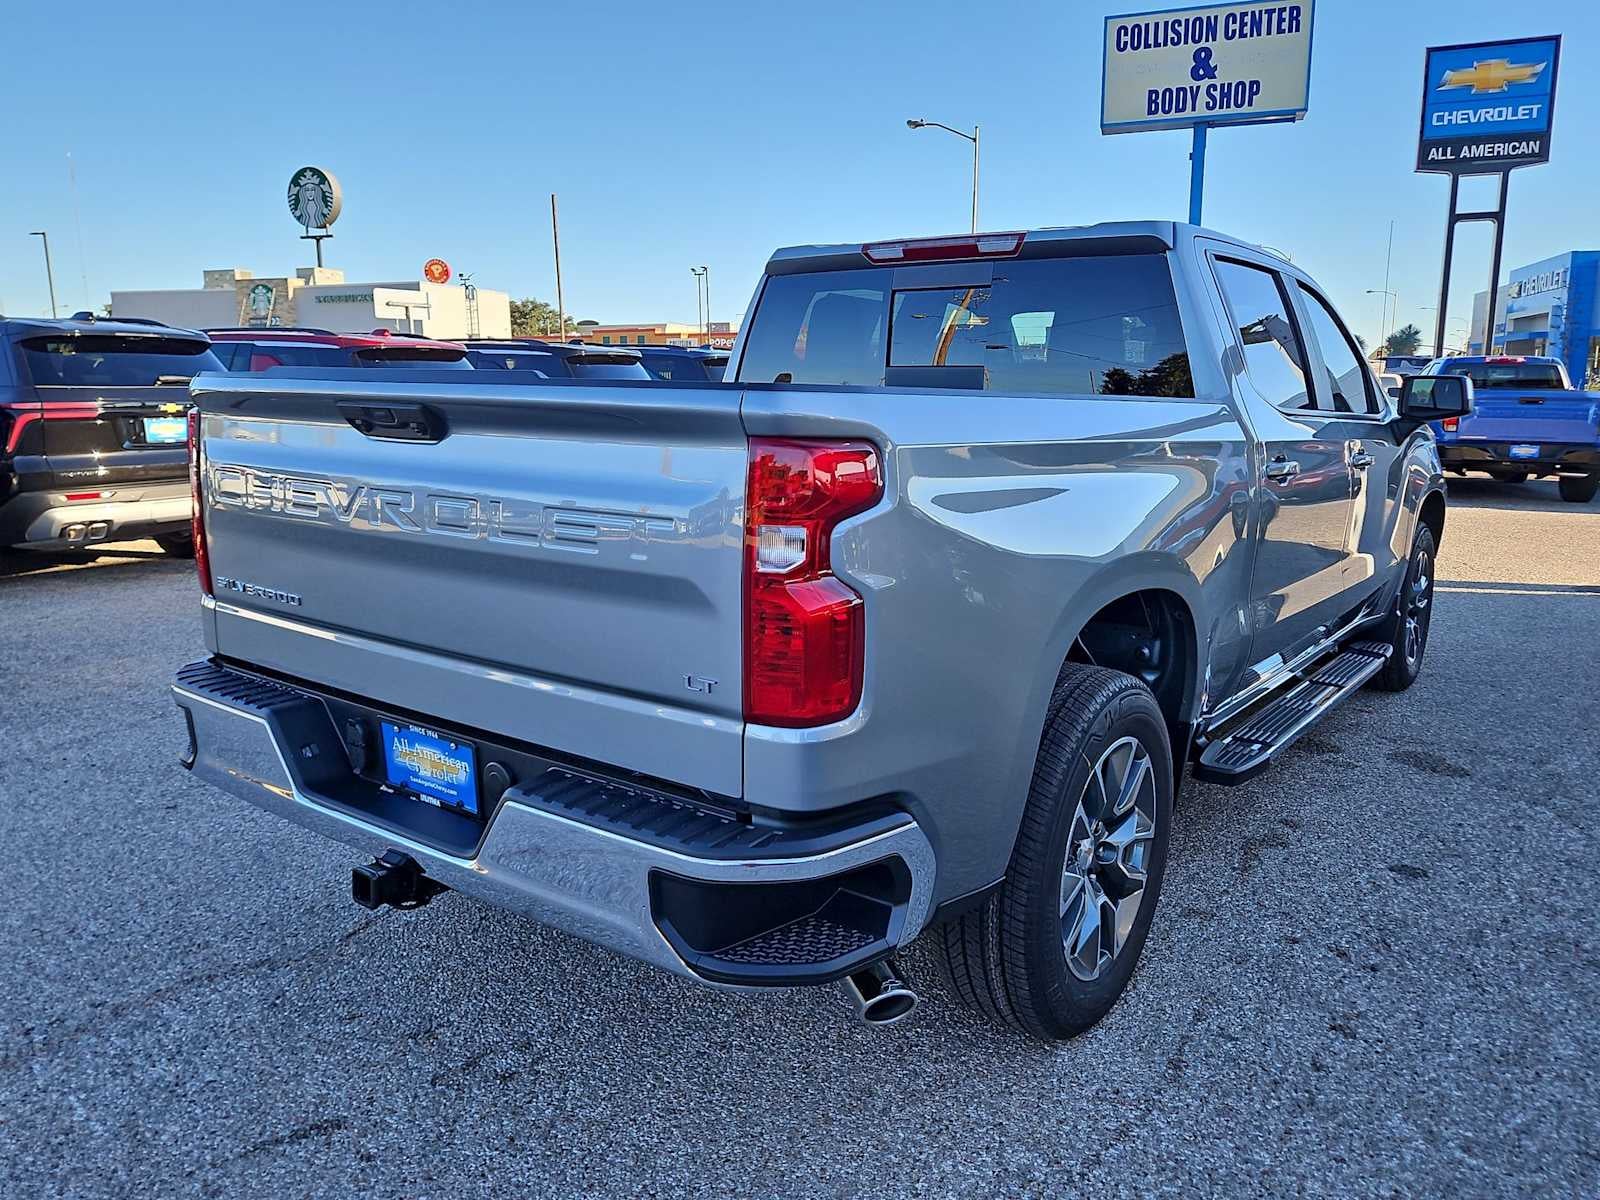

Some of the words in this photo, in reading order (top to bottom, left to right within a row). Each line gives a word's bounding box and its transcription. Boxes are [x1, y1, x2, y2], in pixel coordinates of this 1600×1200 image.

[1116, 15, 1219, 52] COLLISION
[1224, 6, 1301, 41] CENTER
[1190, 47, 1217, 81] &
[1147, 85, 1201, 116] BODY
[1205, 80, 1261, 111] SHOP
[1432, 104, 1542, 126] CHEVROLET
[1428, 146, 1456, 160] ALL
[1460, 141, 1540, 158] AMERICAN
[1521, 267, 1569, 296] CHEVROLET
[213, 467, 676, 559] CHEVROLET
[217, 576, 302, 606] SILVERADO
[683, 675, 718, 694] LT
[393, 737, 409, 753] All
[413, 743, 470, 772] American
